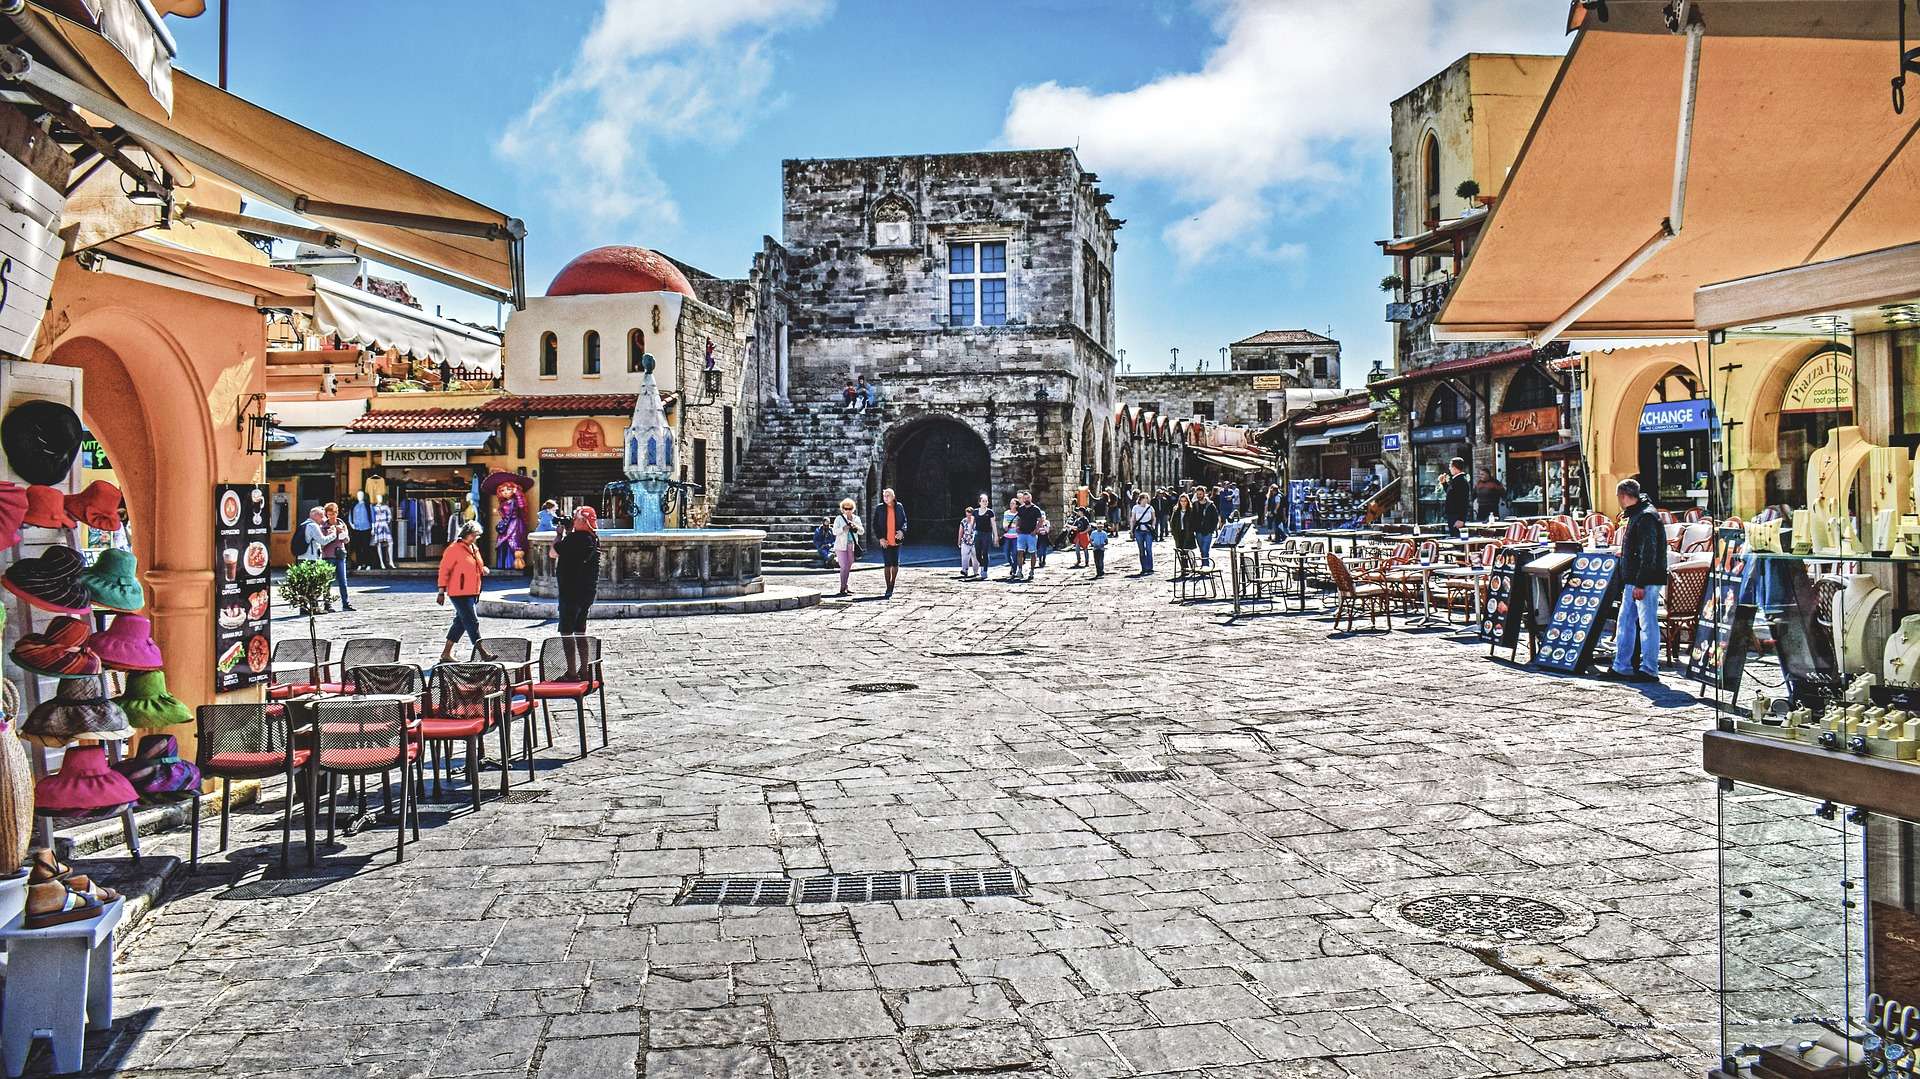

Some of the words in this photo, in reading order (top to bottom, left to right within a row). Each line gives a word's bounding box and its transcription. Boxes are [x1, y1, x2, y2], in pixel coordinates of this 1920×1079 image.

[1791, 365, 1824, 403] Piazza
[1640, 408, 1693, 426] XCHANGE
[1386, 438, 1397, 447] ATM
[385, 450, 416, 461] HARIS
[418, 450, 462, 461] COTTON
